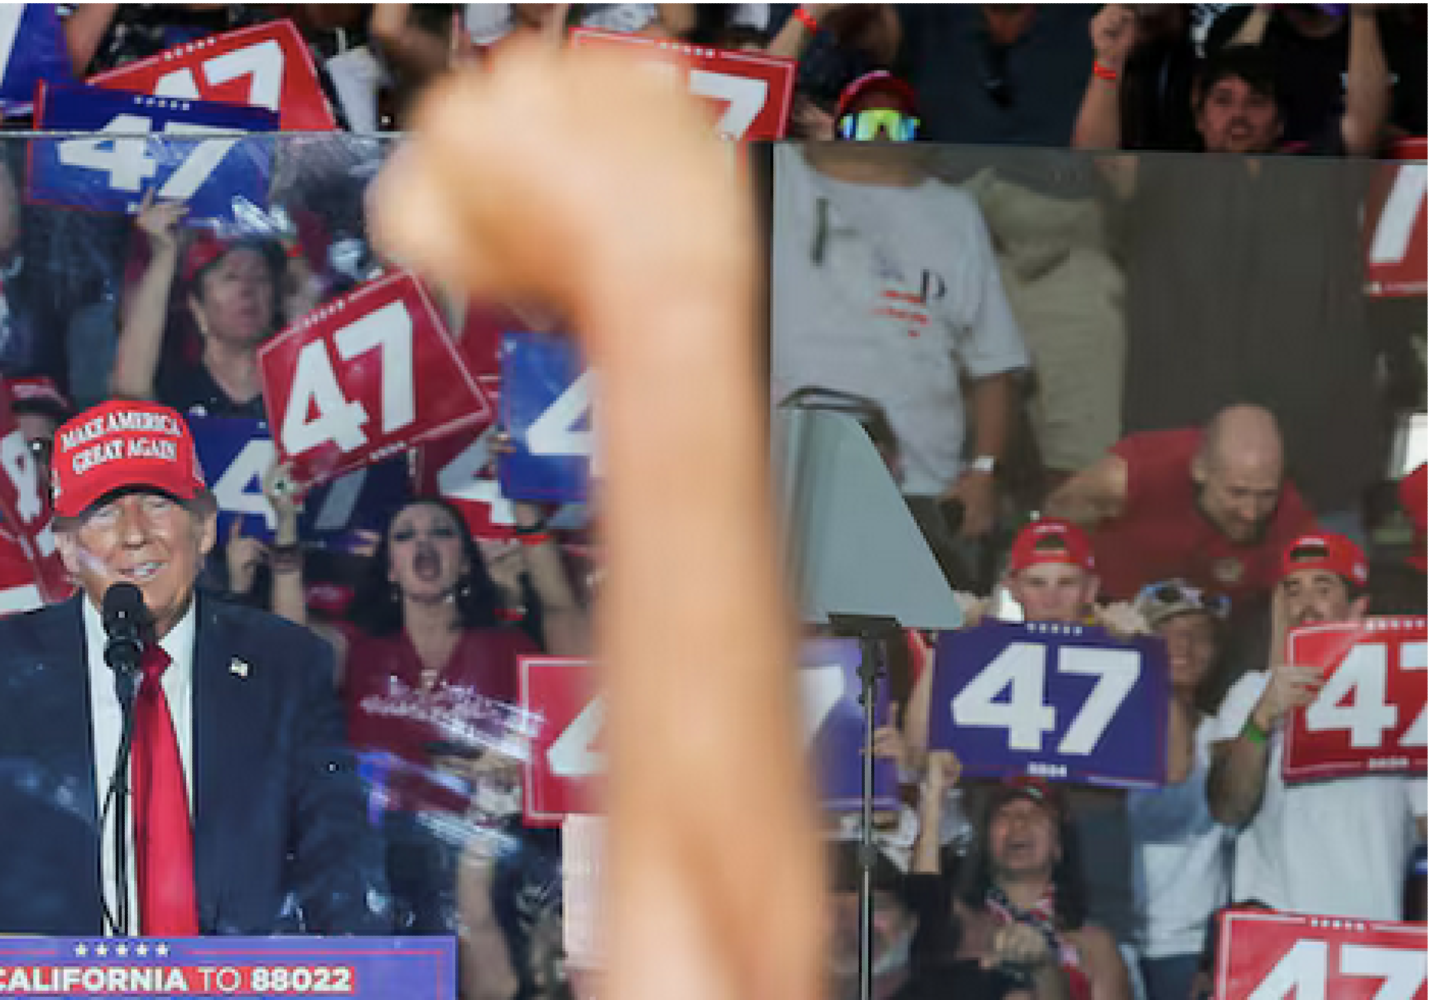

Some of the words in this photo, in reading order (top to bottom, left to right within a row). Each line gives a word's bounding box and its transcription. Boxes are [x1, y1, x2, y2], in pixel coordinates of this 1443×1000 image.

[689, 69, 767, 141] 7
[58, 113, 252, 198] 47
[280, 300, 415, 455] 47
[524, 371, 601, 456] 4
[61, 416, 105, 453] MAKE
[106, 412, 181, 437] AMERICA
[73, 439, 123, 474] GREAT
[127, 437, 177, 461] AGAIN
[436, 435, 518, 525] 4
[547, 699, 608, 778] 4
[952, 641, 1141, 755] 47
[199, 967, 241, 992] TO
[251, 967, 352, 992] 88022
